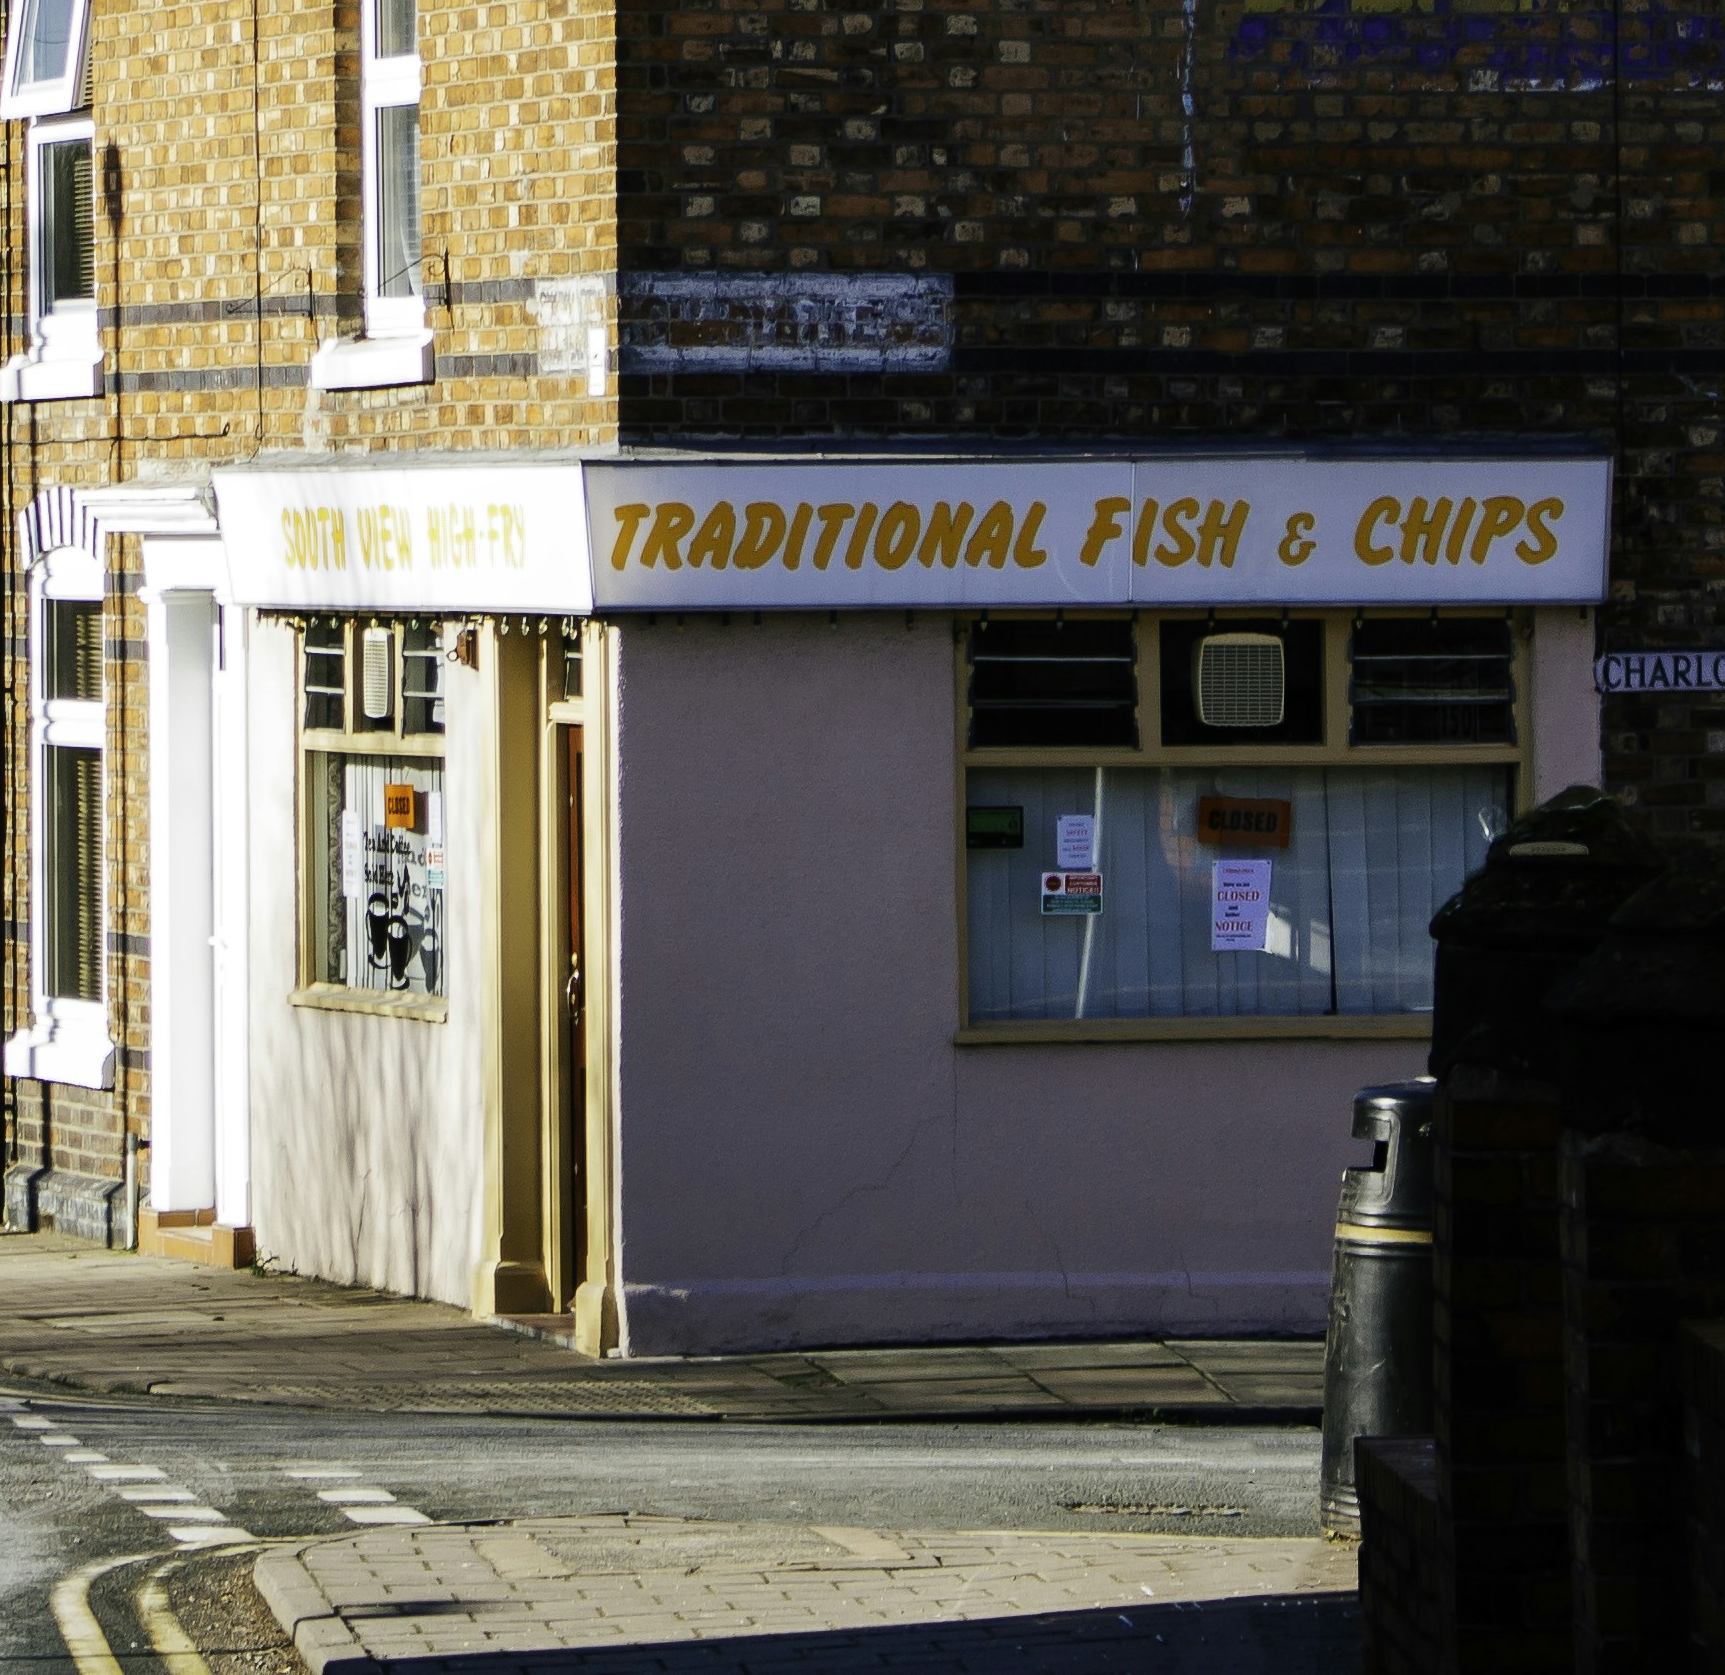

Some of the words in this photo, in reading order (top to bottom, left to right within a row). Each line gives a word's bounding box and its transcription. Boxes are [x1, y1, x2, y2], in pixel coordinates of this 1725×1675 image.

[281, 506, 346, 571] SOUTH
[357, 504, 412, 571] VIEW
[611, 501, 1047, 570] TRADITIONAL
[1080, 497, 1249, 567] FISH
[1279, 513, 1315, 566] &
[1355, 496, 1564, 566] CHIPS
[388, 796, 410, 815] CLOSED
[1209, 809, 1278, 832] CLOSED
[1217, 891, 1260, 902] CLOSED
[1215, 921, 1253, 932] NOTICE
